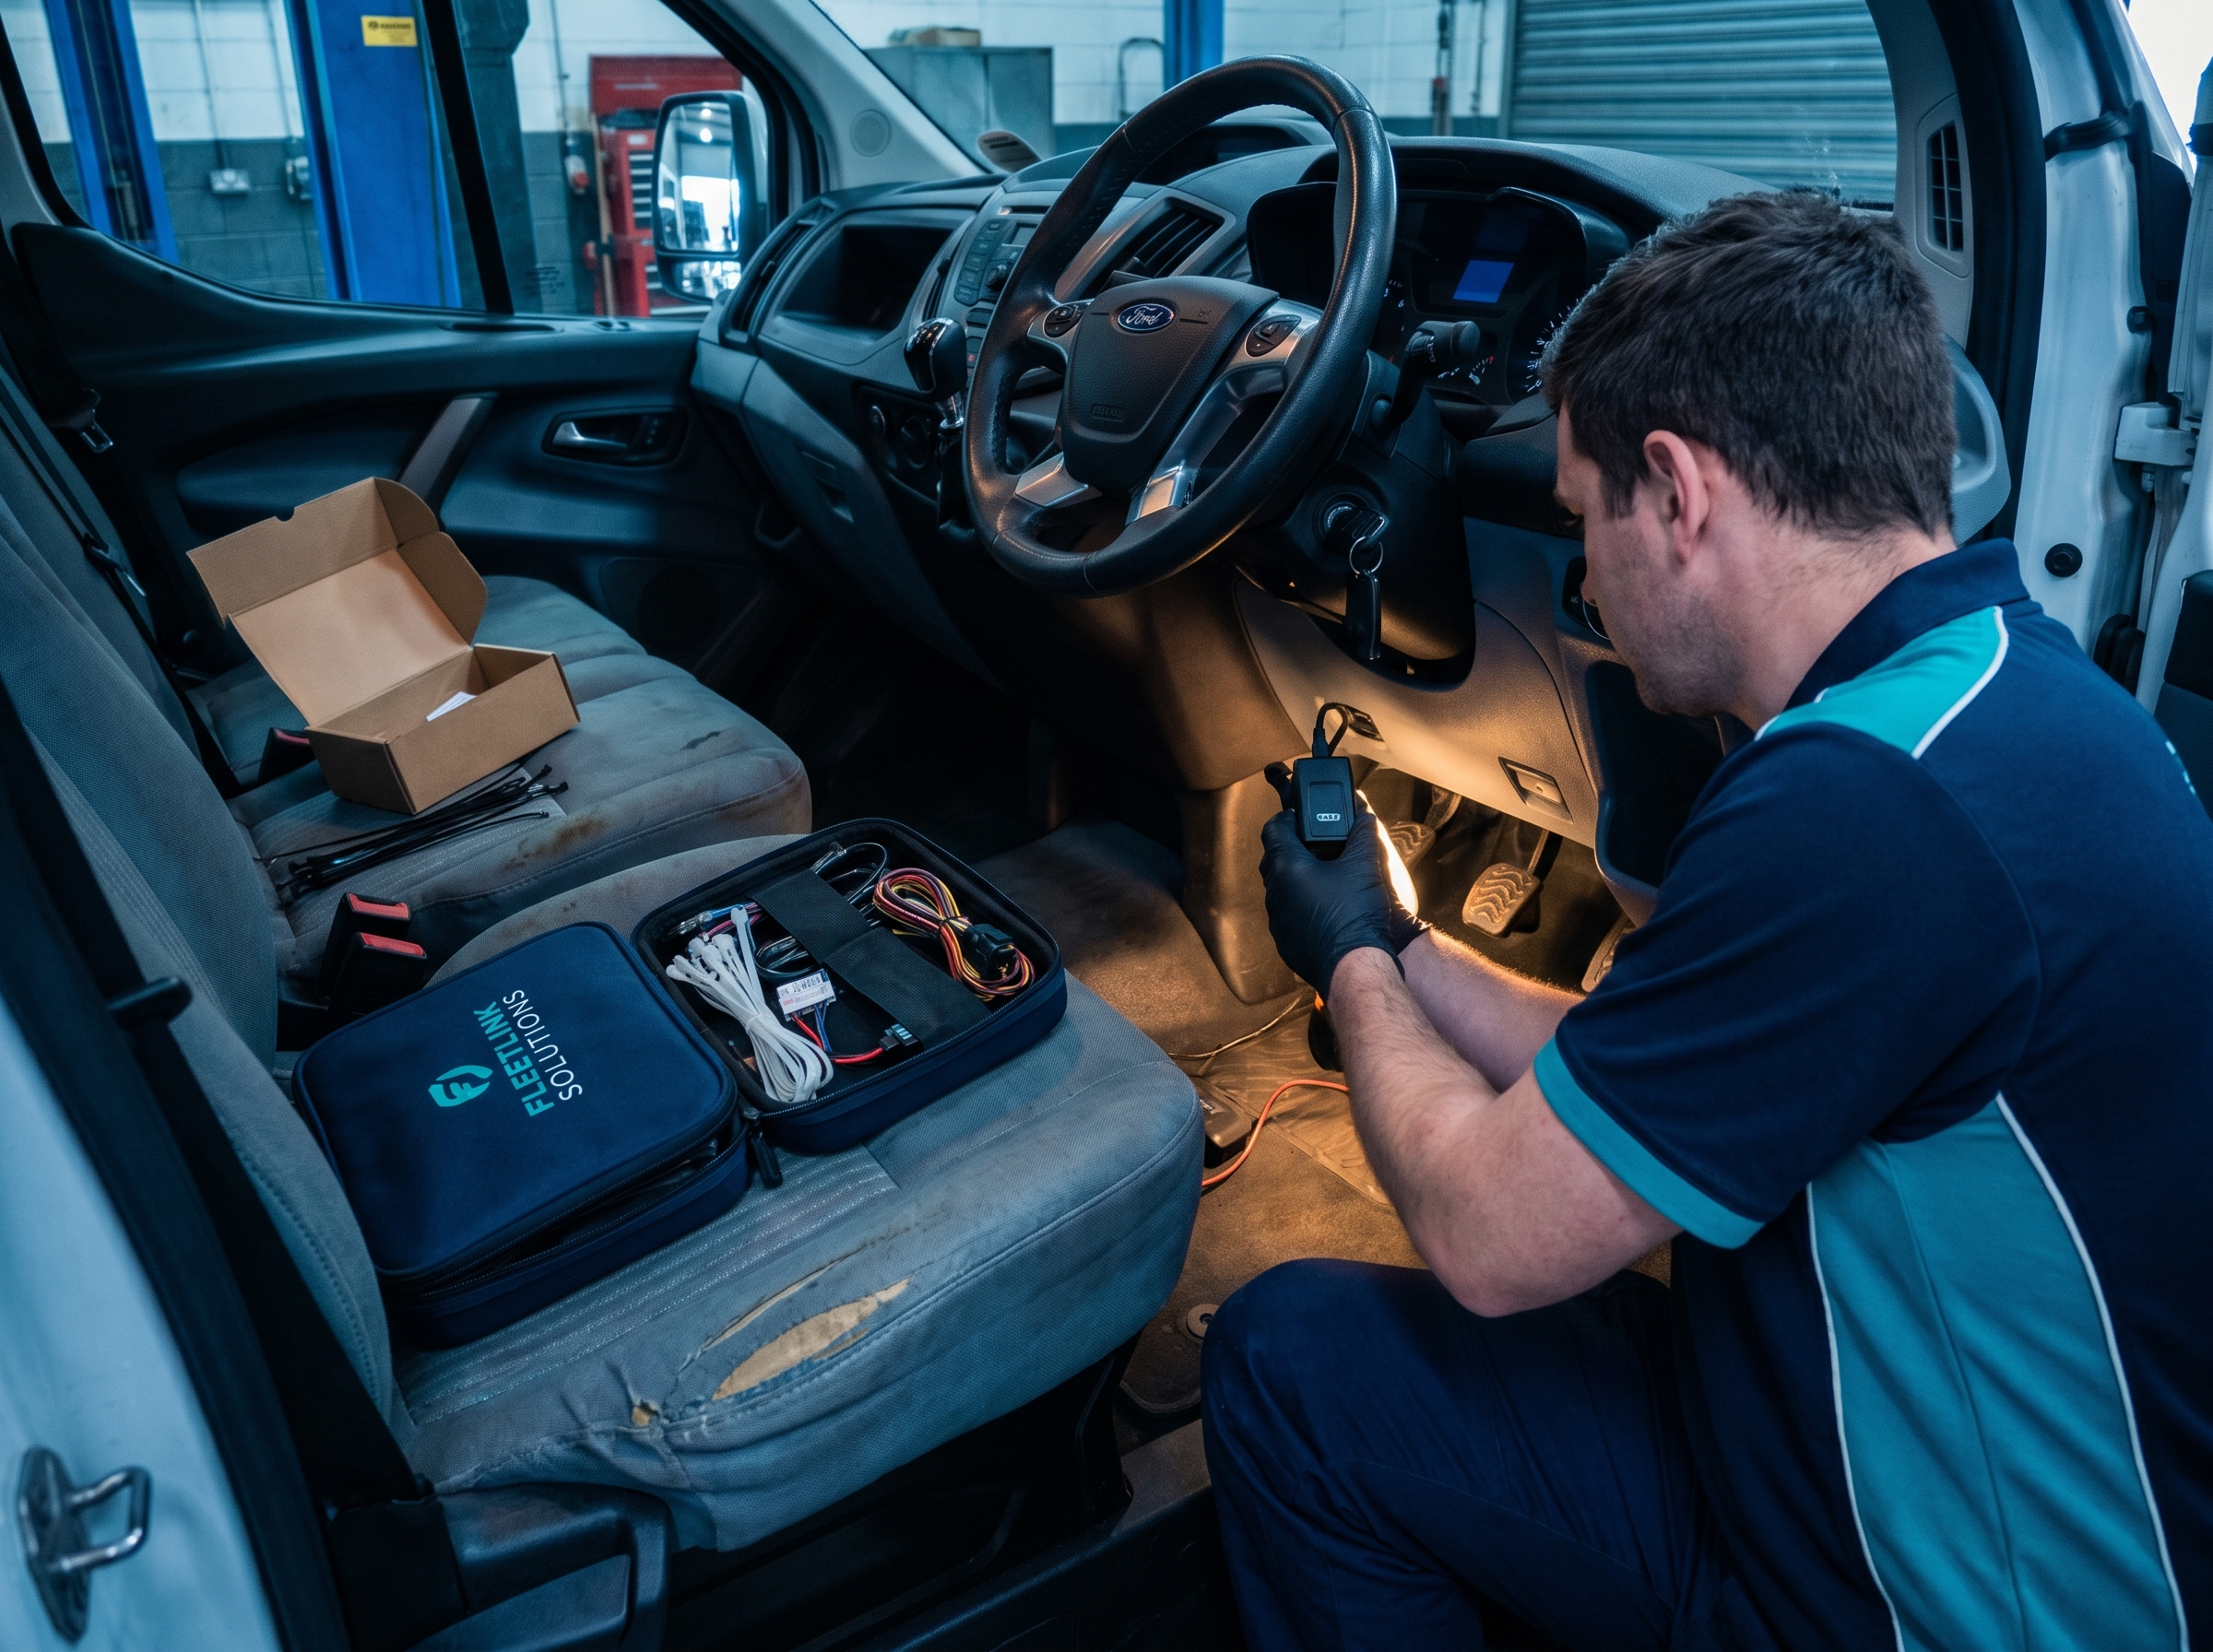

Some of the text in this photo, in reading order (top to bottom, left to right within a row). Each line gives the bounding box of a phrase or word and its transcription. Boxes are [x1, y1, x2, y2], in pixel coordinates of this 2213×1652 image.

[1125, 305, 1164, 325] Ford
[473, 1001, 555, 1116] FLEETLINK
[503, 989, 583, 1101] SOLUTIONS
